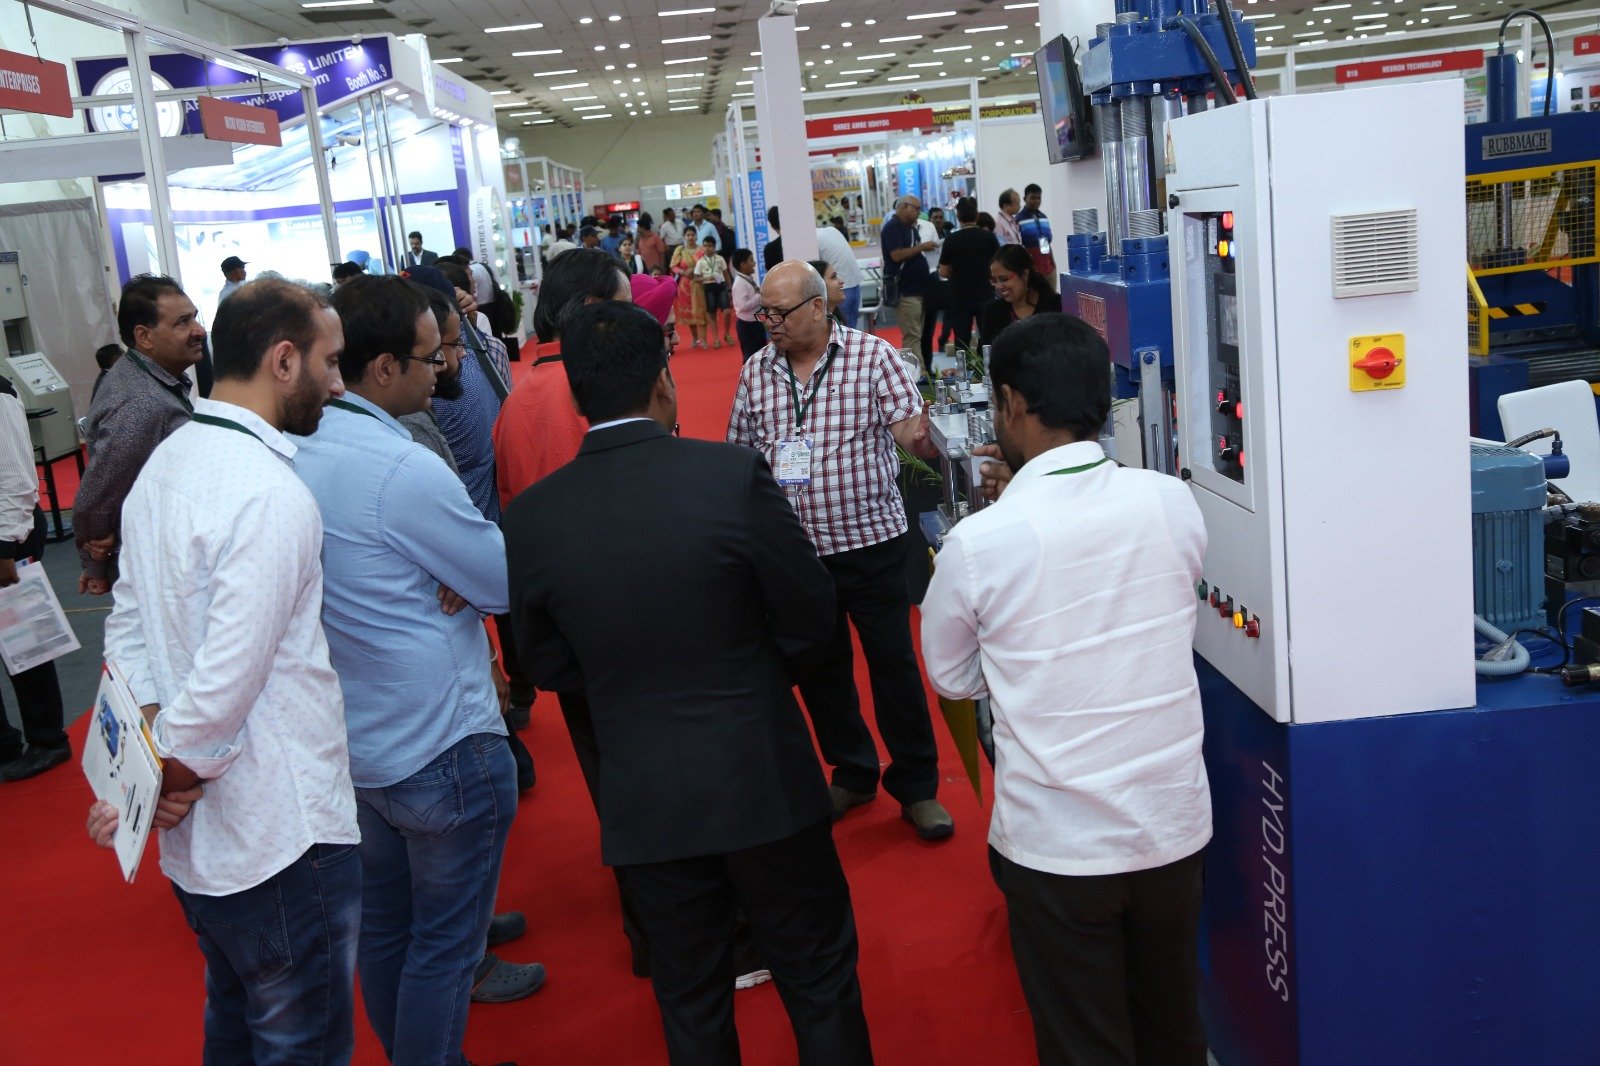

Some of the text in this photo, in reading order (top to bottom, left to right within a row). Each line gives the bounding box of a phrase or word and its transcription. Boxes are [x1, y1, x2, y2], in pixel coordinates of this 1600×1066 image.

[1407, 60, 1442, 70] TECHNOLOGY
[345, 63, 387, 91] Booth No. 9
[933, 106, 1032, 124] AUTOMOTI CORPORATION
[833, 122, 851, 131] SHREE
[1488, 132, 1548, 153] RUBBMACH
[750, 180, 767, 227] SHREE
